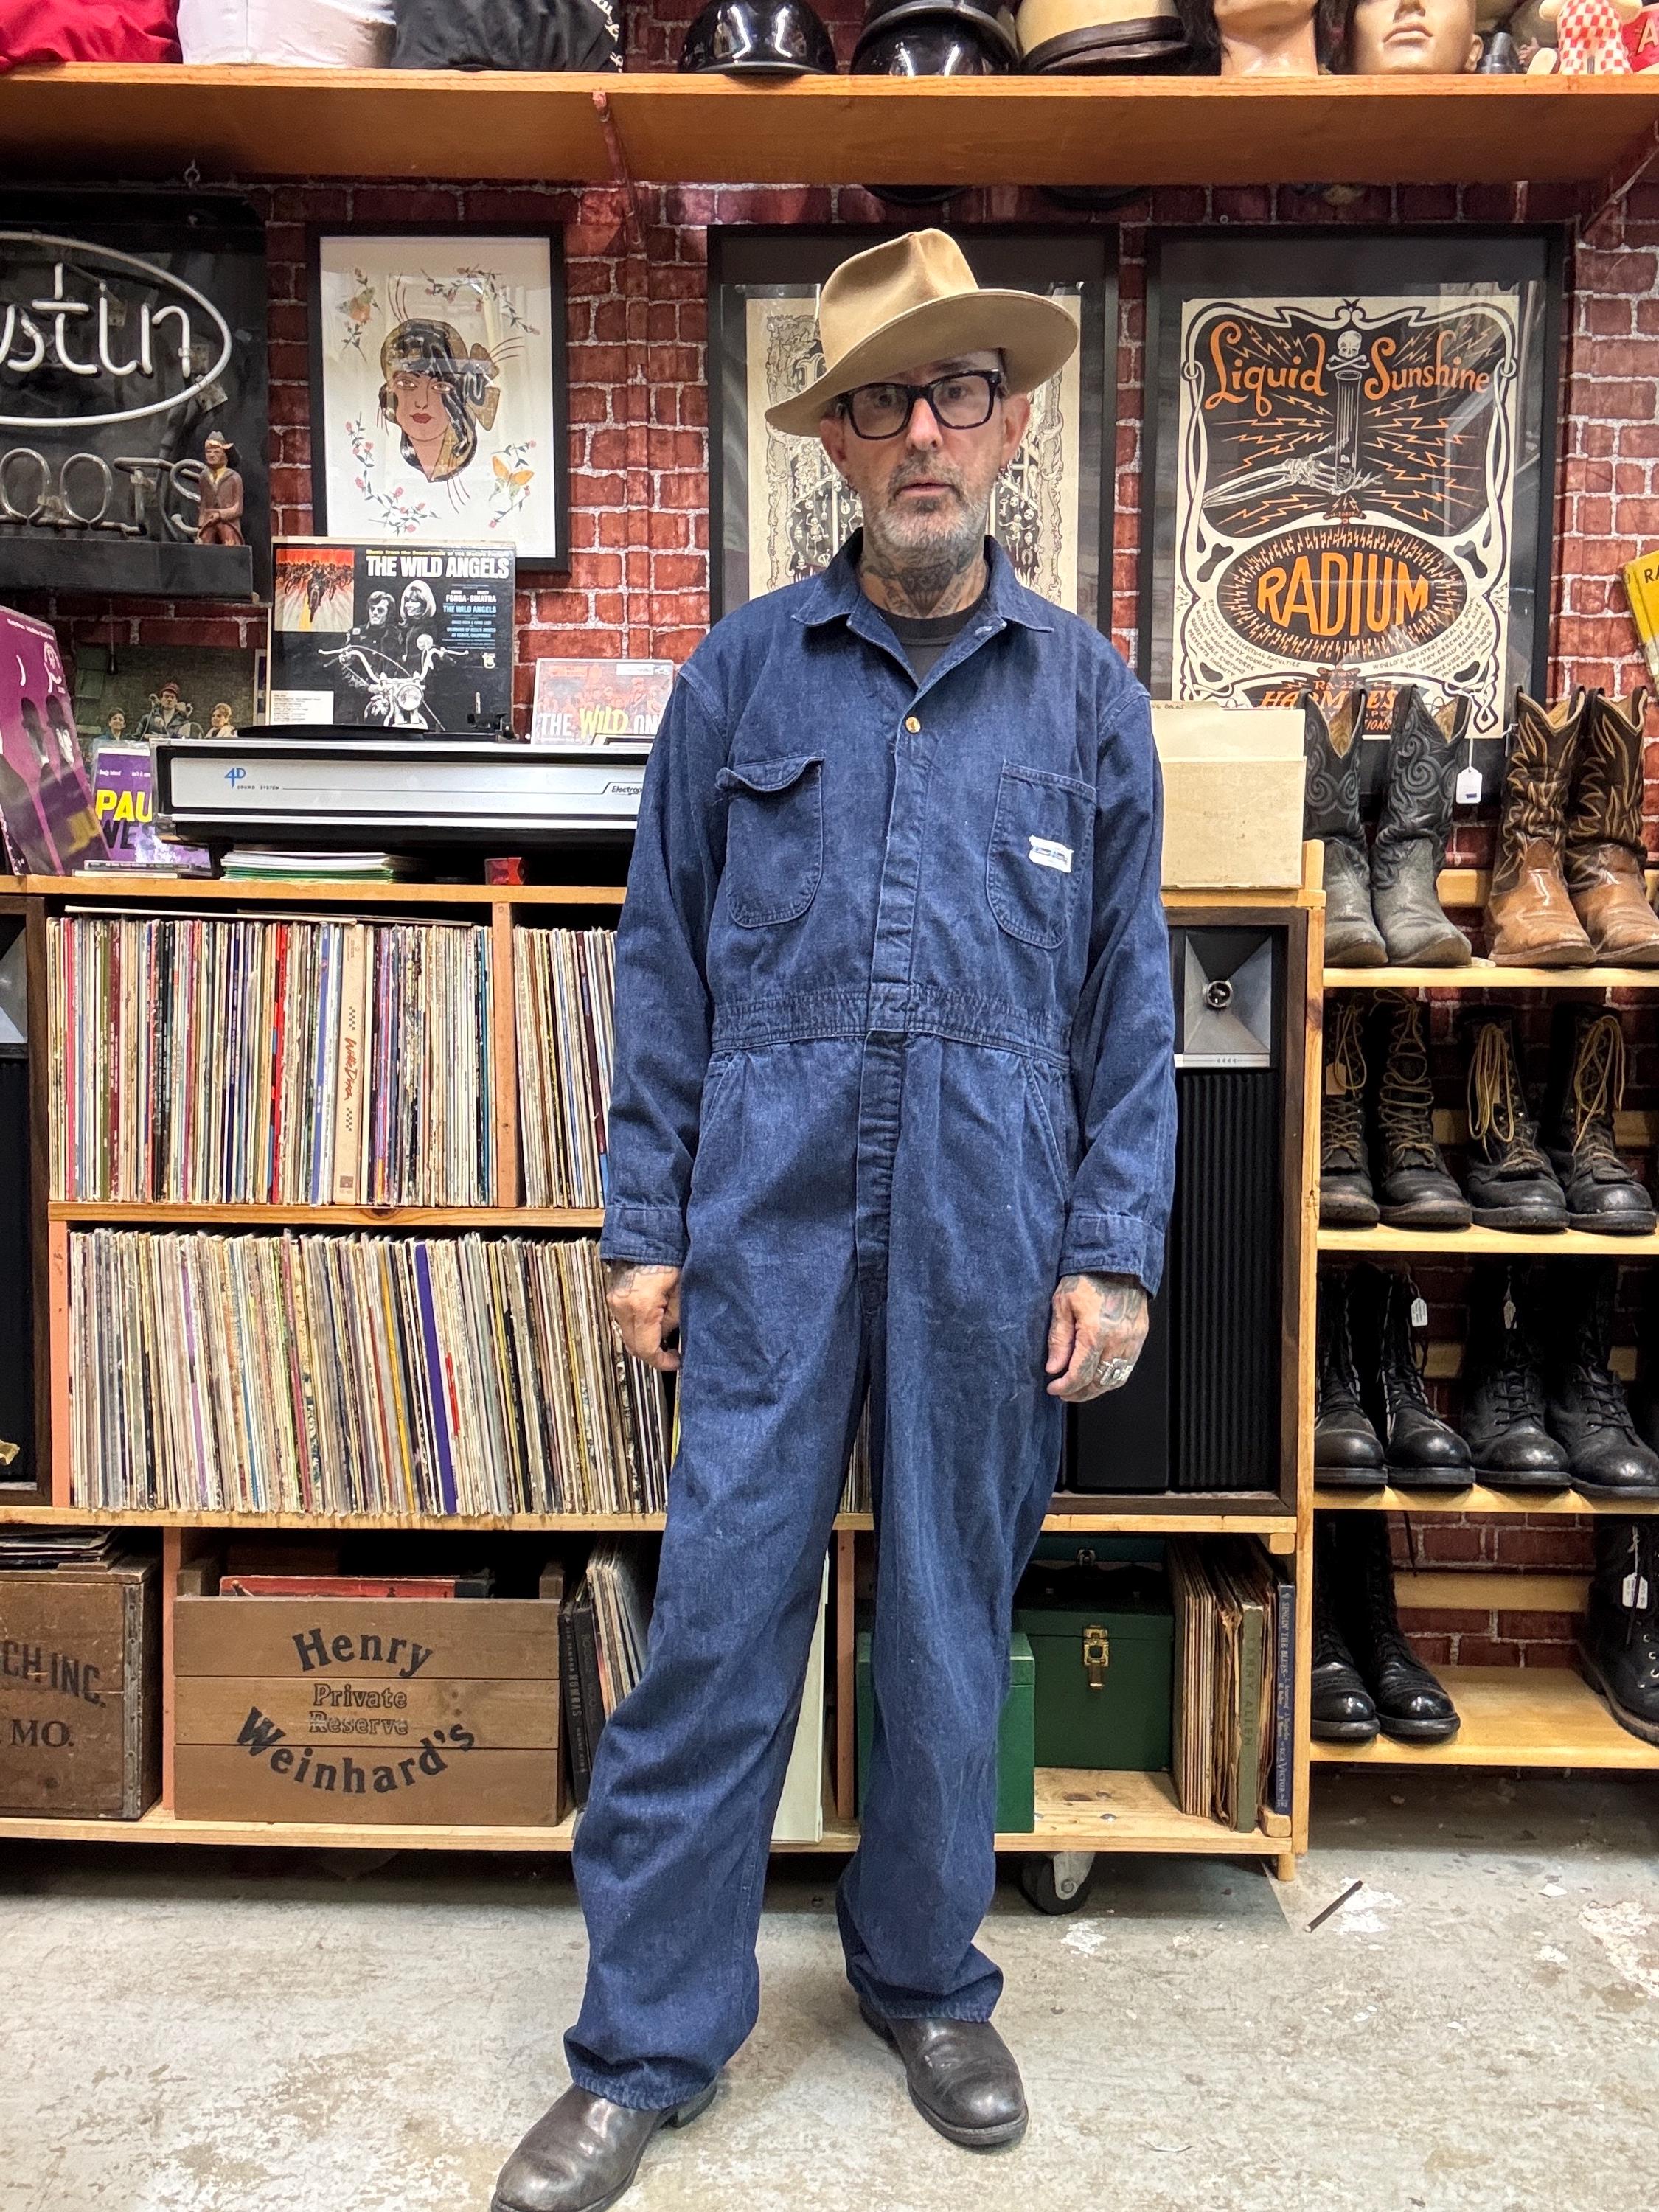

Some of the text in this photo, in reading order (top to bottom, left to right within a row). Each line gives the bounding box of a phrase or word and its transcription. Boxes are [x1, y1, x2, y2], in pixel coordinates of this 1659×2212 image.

[1205, 321, 1491, 415] Liquid Sunshine
[366, 556, 509, 579] THE WILD ANGELS
[1257, 552, 1430, 636] RADIUM
[1228, 631, 1265, 658] INTELLECTUAL
[1267, 655, 1301, 667] FACULTIES
[1406, 643, 1439, 661] GREATEST
[540, 704, 662, 739] THE WILD ON
[292, 1627, 434, 1677] Henry
[51, 1652, 107, 1708] INC.
[313, 1683, 408, 1708] Private
[9, 1719, 74, 1747] MO.
[309, 1711, 408, 1736] Reserve
[237, 1705, 476, 1794] Weinhard's
